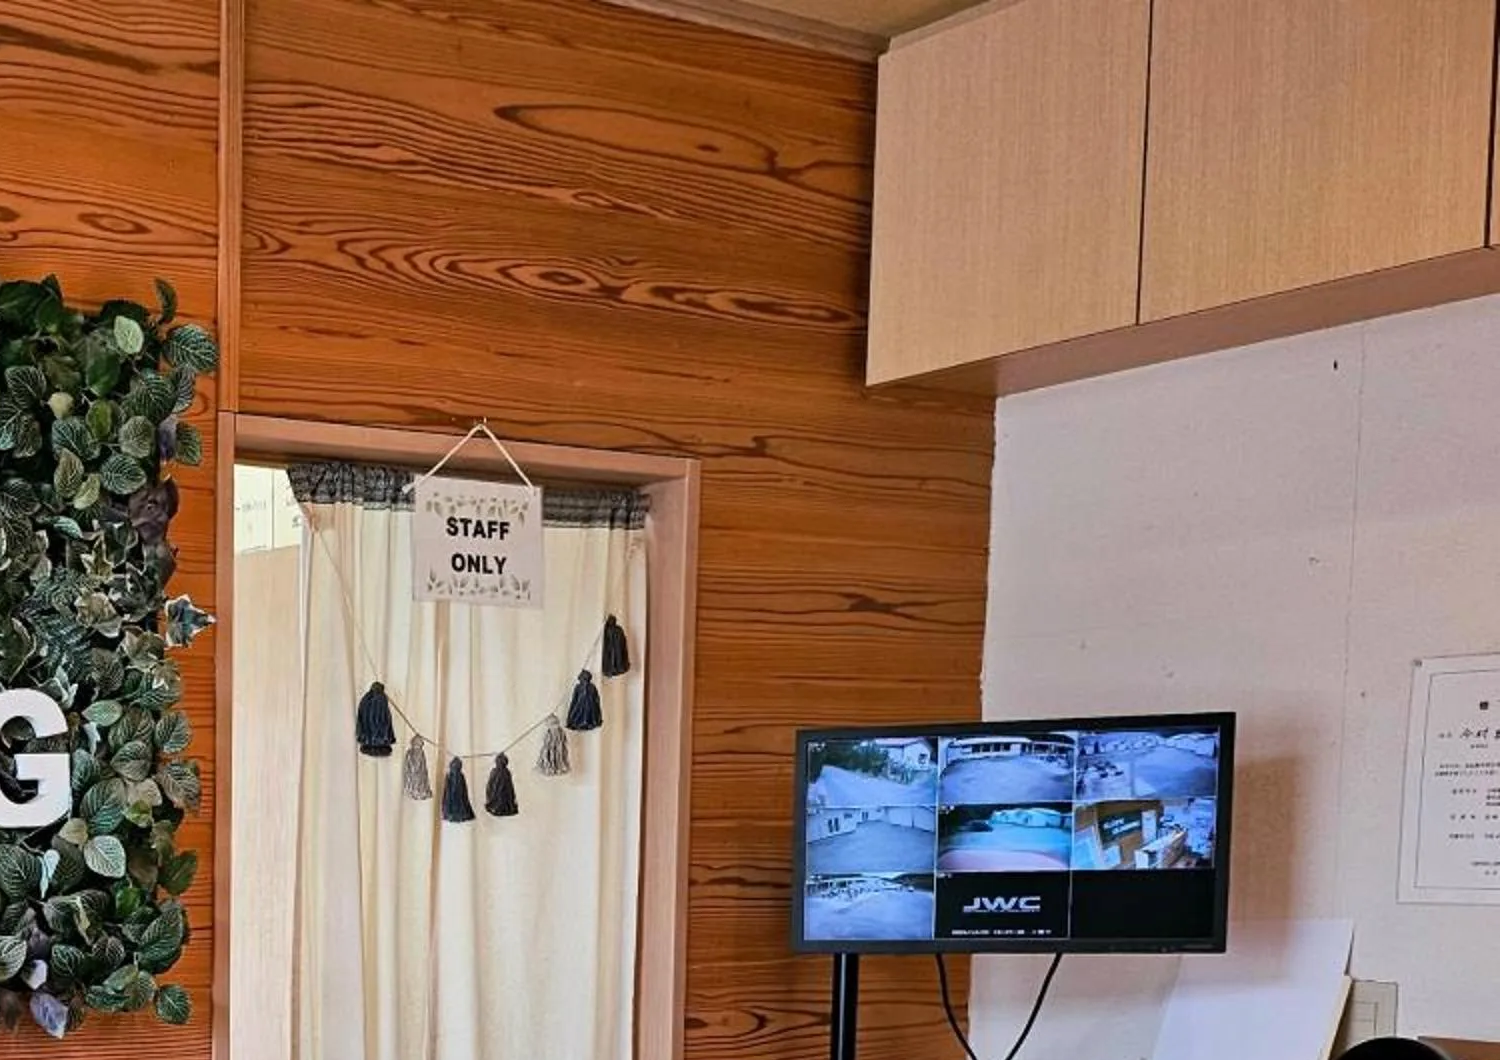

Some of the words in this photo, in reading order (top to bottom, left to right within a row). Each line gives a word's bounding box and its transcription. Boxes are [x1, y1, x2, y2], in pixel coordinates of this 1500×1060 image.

[446, 516, 510, 540] STAFF
[451, 553, 507, 575] ONLY
[963, 896, 1041, 912] JWC
